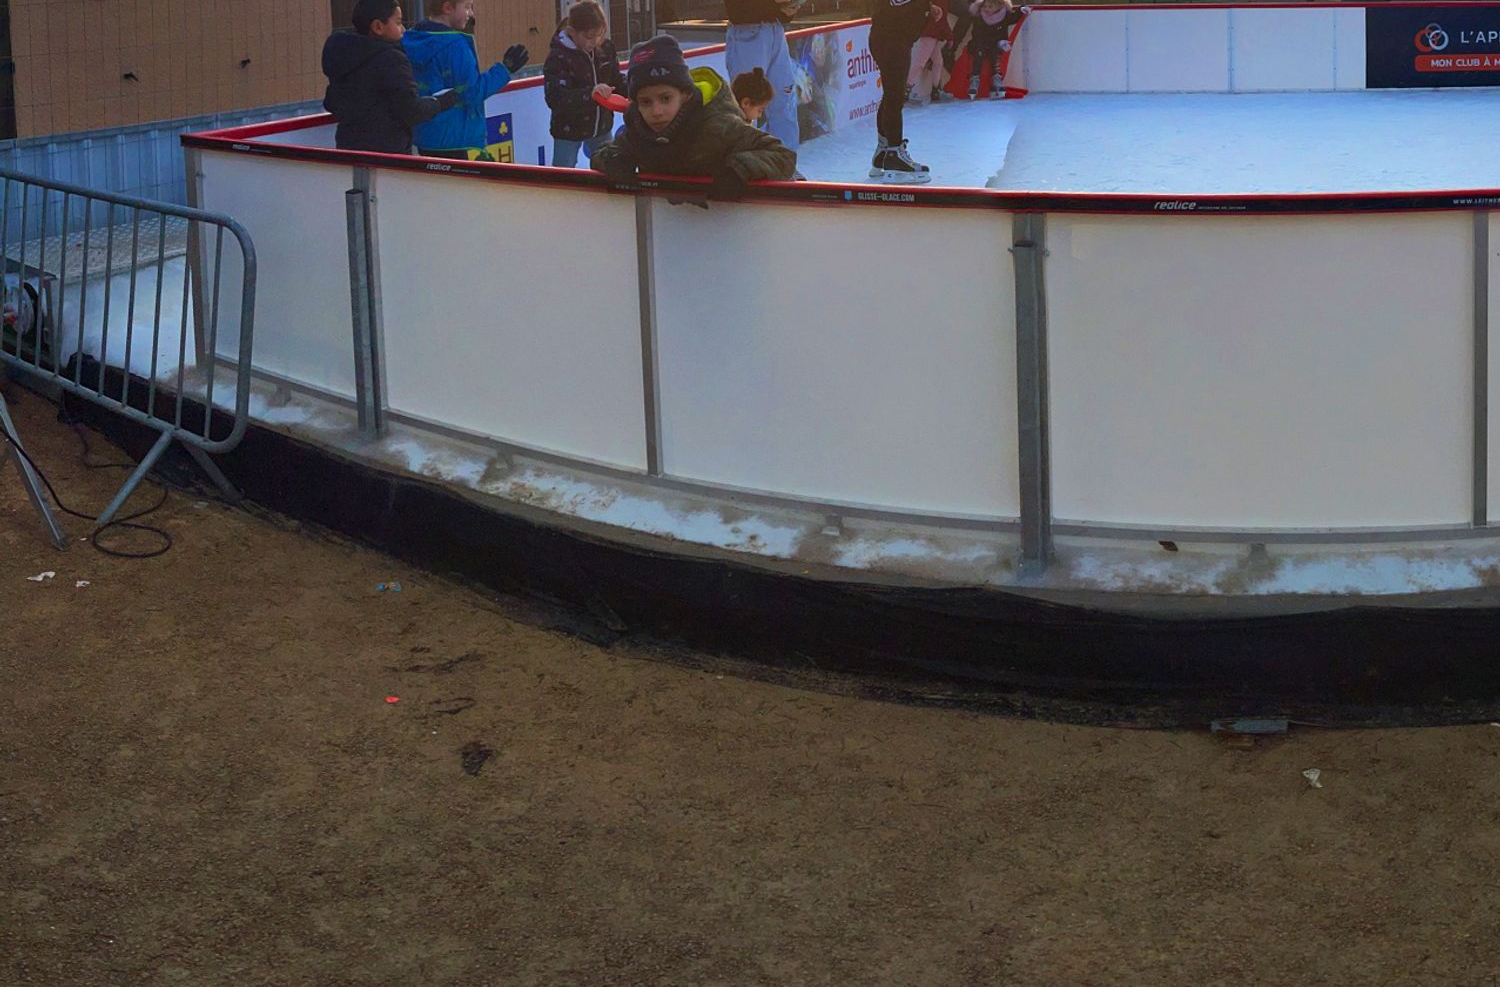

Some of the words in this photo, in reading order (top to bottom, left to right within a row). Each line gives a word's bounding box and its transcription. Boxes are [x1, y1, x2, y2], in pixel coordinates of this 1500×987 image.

[1430, 59, 1452, 67] MON
[1455, 59, 1480, 67] CLUB
[1483, 56, 1491, 66] À
[1153, 201, 1197, 210] realice
